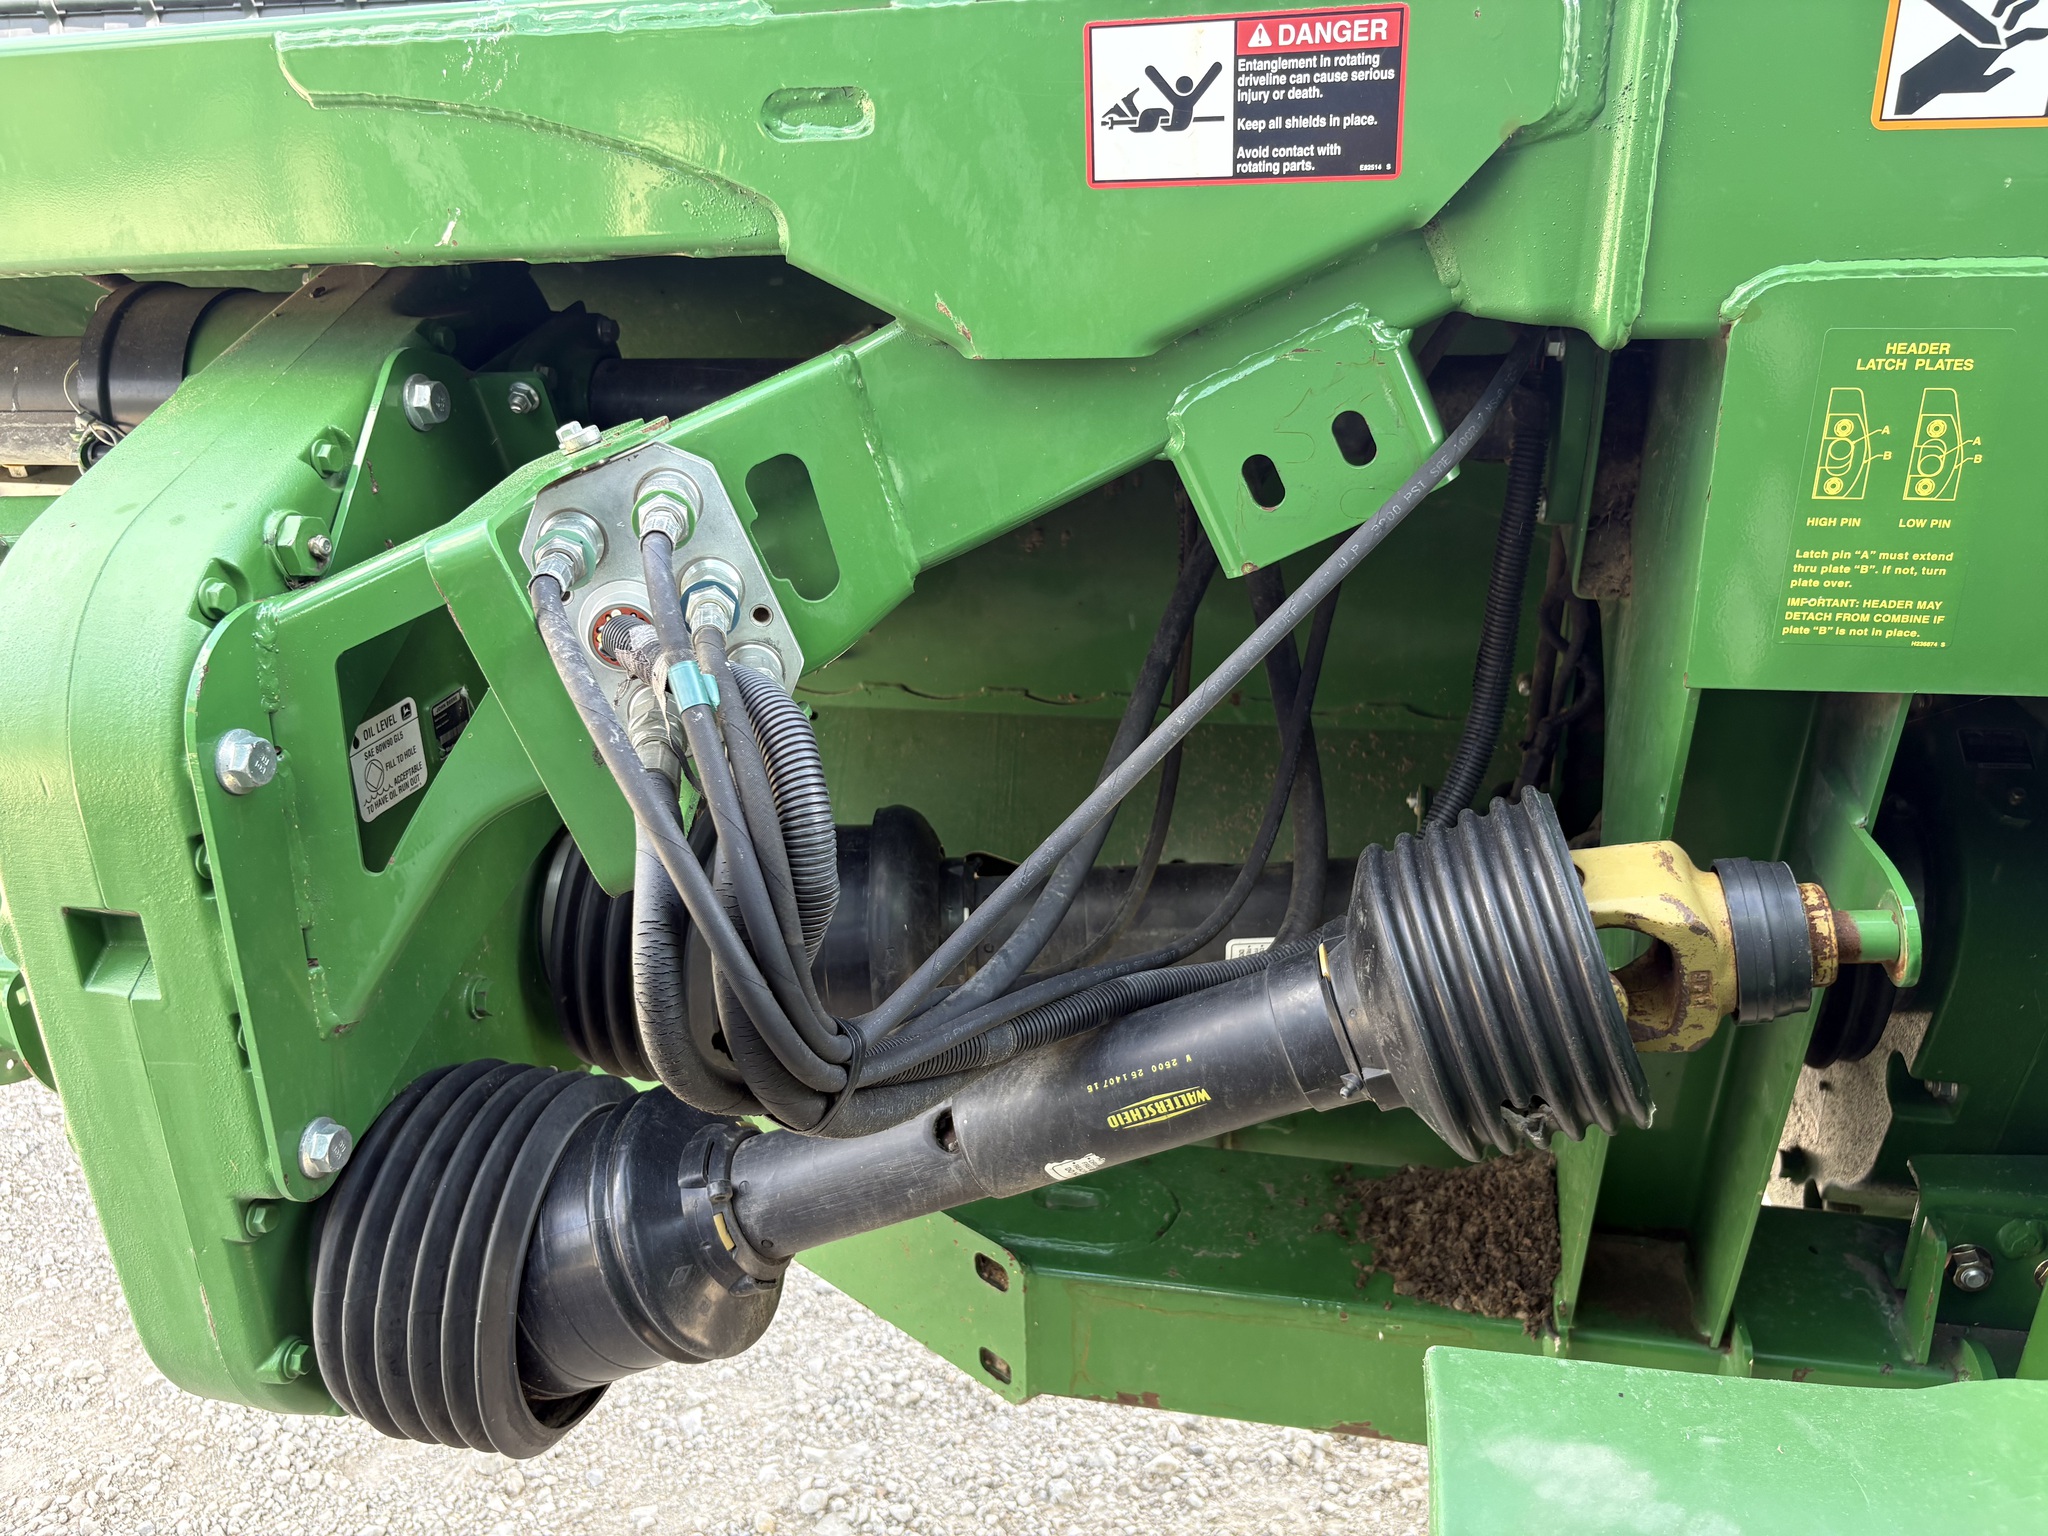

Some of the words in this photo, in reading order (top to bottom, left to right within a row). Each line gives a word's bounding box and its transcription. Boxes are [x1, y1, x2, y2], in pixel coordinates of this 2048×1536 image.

[1279, 19, 1387, 45] DANGER
[1238, 57, 1317, 73] Entanglement
[1320, 57, 1330, 67] in
[1334, 53, 1380, 70] rotating
[1238, 72, 1286, 87] driveline
[1289, 72, 1310, 83] can
[1314, 70, 1347, 83] cause
[1351, 69, 1394, 81] serious
[1238, 89, 1269, 104] injury
[1273, 90, 1285, 99] or
[1288, 87, 1322, 99] death.
[1238, 118, 1265, 132] Keep
[1268, 117, 1283, 129] all
[1285, 115, 1325, 129] shields
[1329, 115, 1340, 126] in
[1343, 114, 1377, 129] place.
[1237, 145, 1269, 159] Avoid
[1272, 144, 1314, 158] contact
[1317, 143, 1341, 156] with
[1237, 159, 1280, 176] rotating
[1283, 158, 1315, 175] parts.
[1886, 343, 1950, 355] HEADER
[1857, 359, 1906, 370] LATCH
[1915, 359, 1973, 370] PLATES
[1882, 426, 1890, 434] A
[1973, 437, 1981, 445] A
[1883, 451, 1891, 460] B
[1973, 455, 1982, 463] B
[1402, 478, 1427, 504] PSI
[1428, 453, 1452, 478] SAE
[1807, 518, 1836, 526] HIGH
[1840, 518, 1861, 527] PIN
[1899, 519, 1926, 528] LOW
[1930, 519, 1951, 528] PIN
[1796, 550, 1828, 559] Latch
[1831, 551, 1851, 561] pin
[1879, 552, 1909, 560] must
[1913, 552, 1953, 561] extend
[1793, 564, 1817, 573] thru
[1821, 565, 1850, 576] plate
[1883, 565, 1892, 574] If
[1895, 567, 1917, 577] not,
[1922, 567, 1946, 576] turn
[1790, 578, 1820, 589] plate
[1824, 580, 1852, 588] over.
[1787, 598, 1859, 608] IMPORTANT:
[1863, 600, 1913, 609] HEADER
[1917, 600, 1942, 610] MAY
[1785, 612, 1831, 621] DETACH
[1835, 613, 1869, 622] FROM
[1874, 614, 1929, 623] COMBINE
[1933, 615, 1945, 624] IF
[1782, 625, 1810, 636] plate
[1836, 627, 1846, 636] is
[1850, 628, 1869, 636] not
[1872, 628, 1882, 637] in
[1885, 628, 1920, 639] place.
[363, 728, 375, 740] OIL
[376, 714, 397, 733] LEVEL
[364, 747, 375, 760] SAE
[376, 737, 393, 754] 80W90
[394, 731, 404, 744] GL5
[385, 759, 396, 771] FILL
[397, 754, 404, 763] TO
[404, 745, 417, 759] HOLE
[394, 761, 422, 785] ACCEPTABLE
[367, 804, 375, 815] TO
[375, 796, 388, 810] HAVE
[389, 790, 398, 802] OIL
[399, 782, 410, 794] RUN
[411, 774, 421, 787] OUT
[1151, 1058, 1177, 1073] 2500
[1107, 1088, 1211, 1129] WALTERSCHEID
